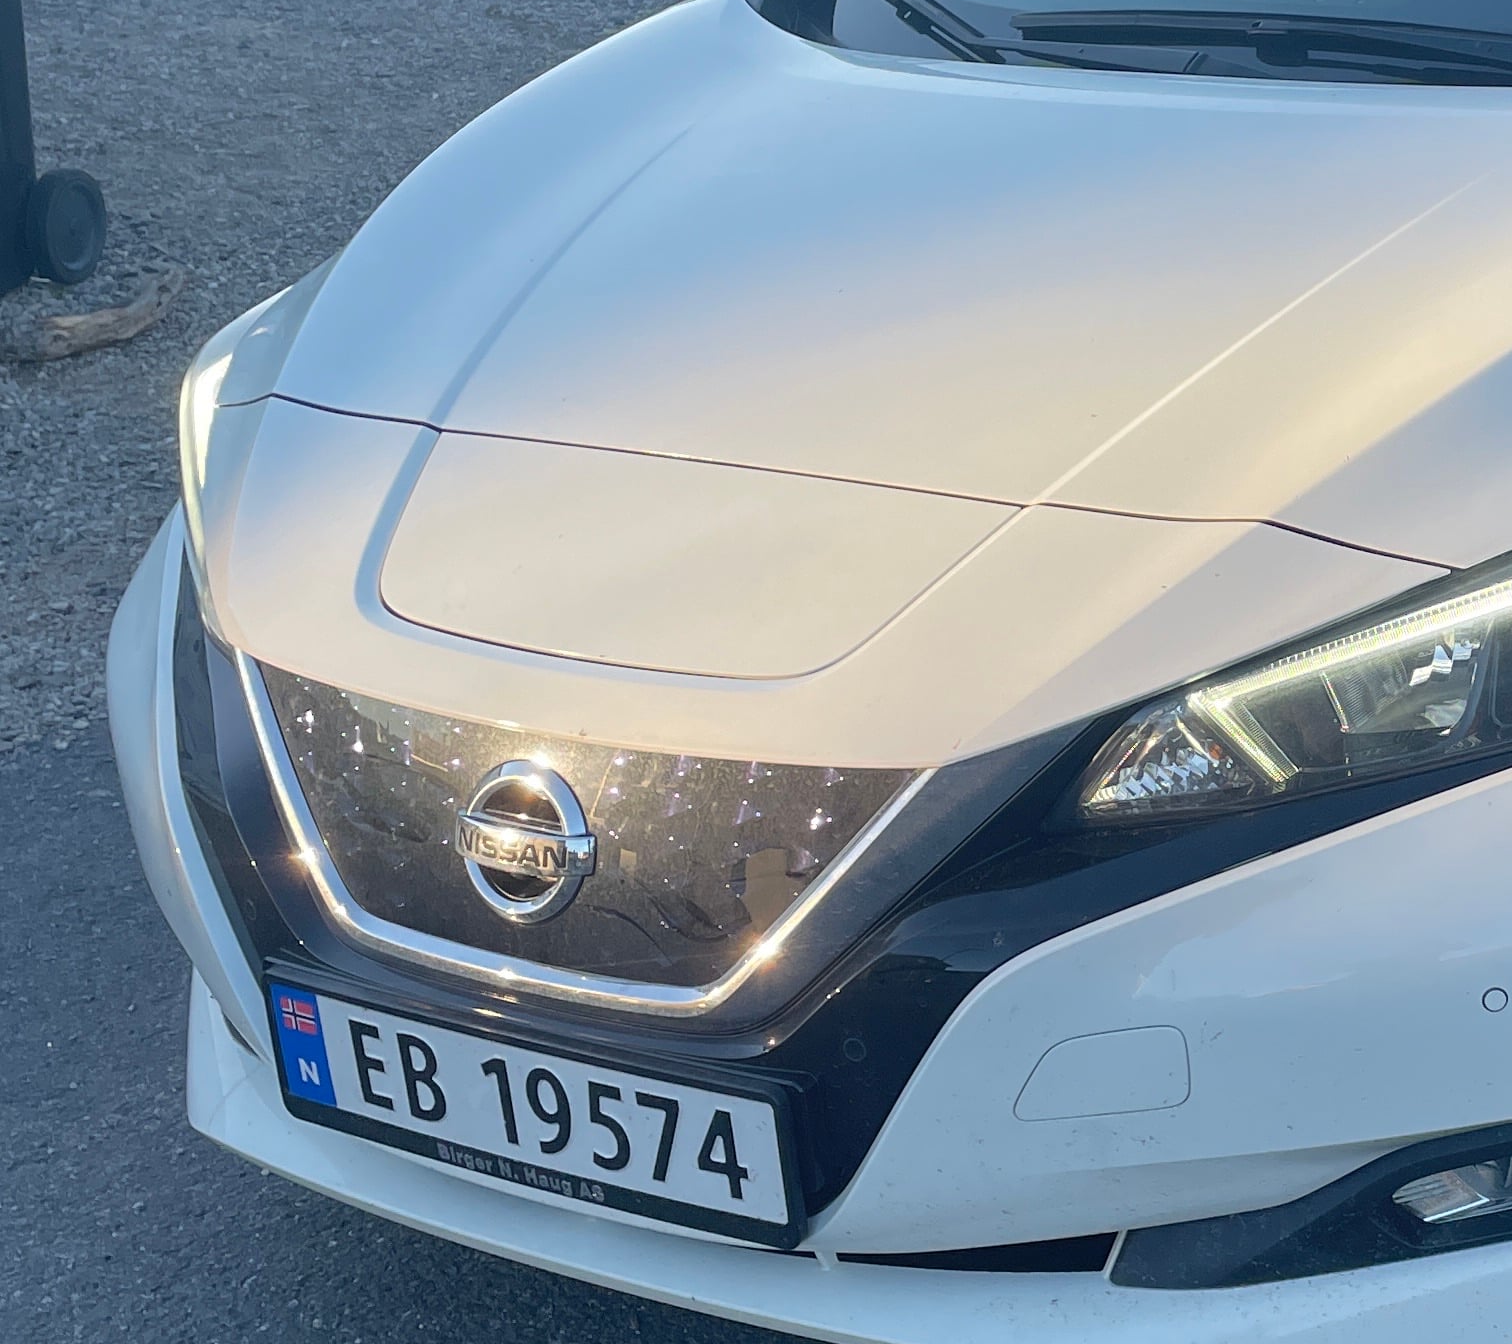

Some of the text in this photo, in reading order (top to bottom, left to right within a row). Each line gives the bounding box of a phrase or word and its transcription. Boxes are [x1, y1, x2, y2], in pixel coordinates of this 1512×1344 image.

[457, 825, 568, 869] NISSAN
[299, 1057, 321, 1086] N
[348, 1018, 749, 1200] EB 19574
[523, 1166, 573, 1197] Haug
